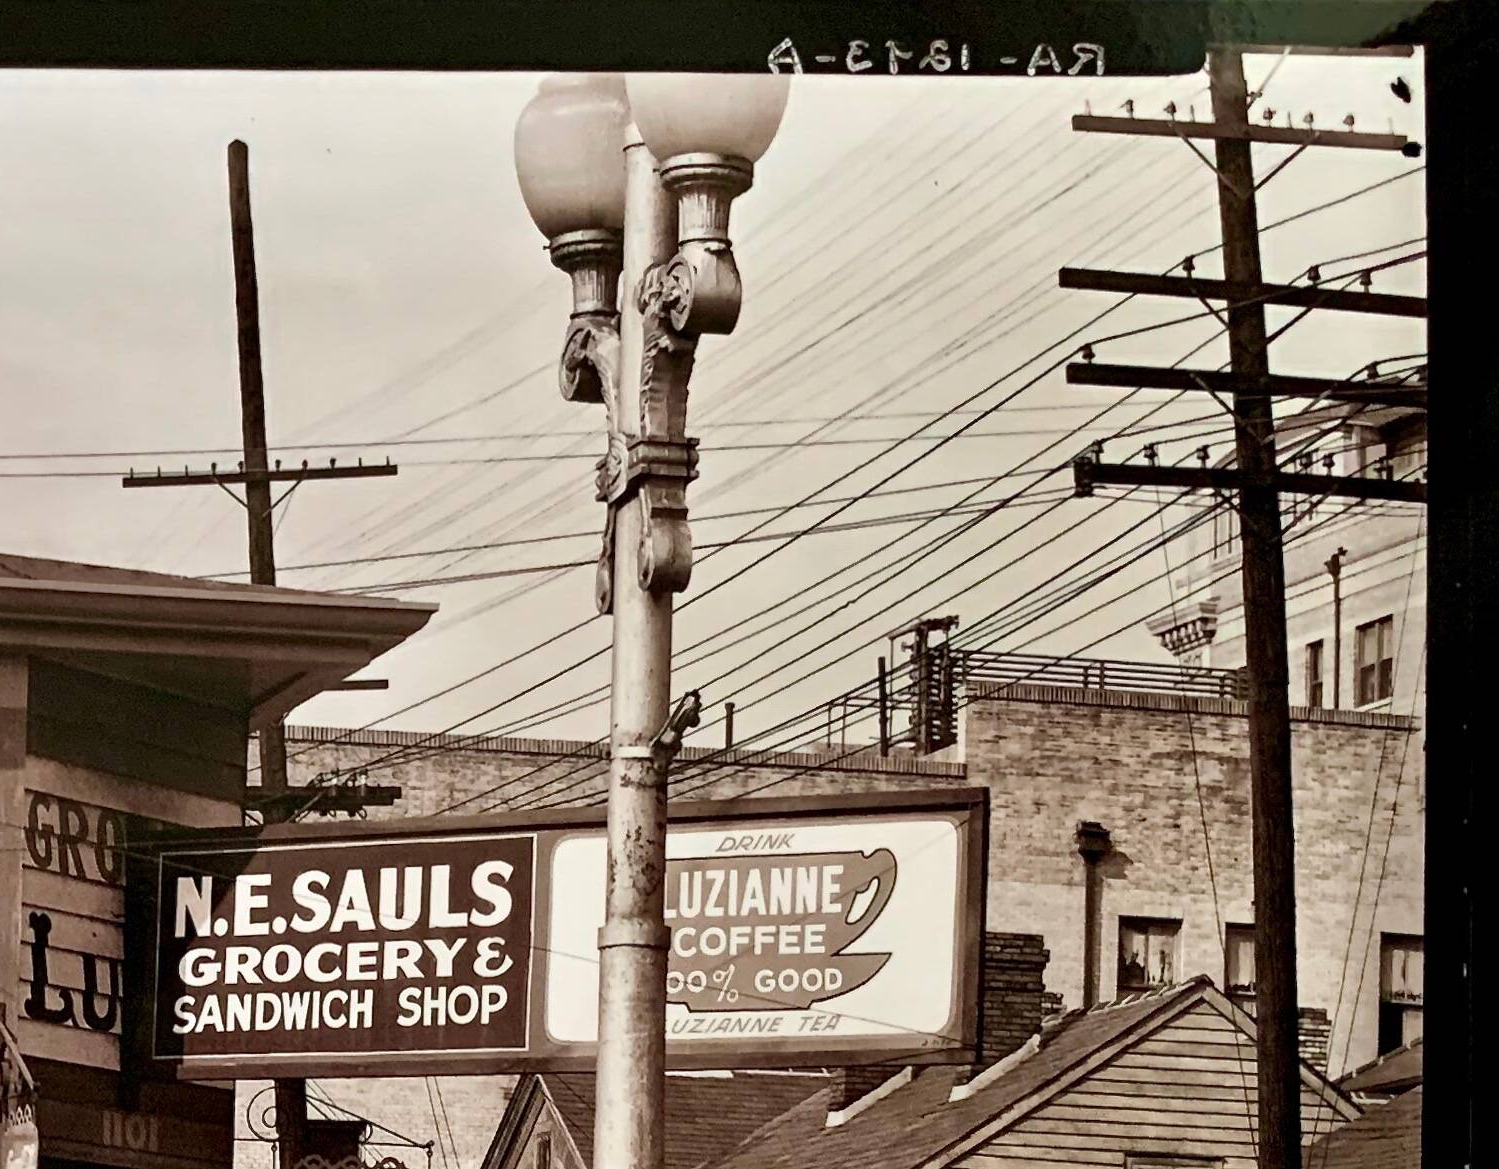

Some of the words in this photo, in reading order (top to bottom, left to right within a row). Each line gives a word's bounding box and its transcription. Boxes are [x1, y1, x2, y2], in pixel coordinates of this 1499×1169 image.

[24, 793, 122, 886] GRO
[716, 834, 796, 852] DRINK
[664, 865, 844, 919] LUZIANNE
[179, 938, 468, 986] GROCERY
[473, 936, 514, 978] &
[674, 924, 827, 957] COFFEE
[24, 911, 121, 1033] LU
[666, 964, 739, 1002] 00%
[755, 968, 843, 993] GOOD
[173, 989, 375, 1034] SANDWICH
[398, 985, 508, 1028] SHOP
[671, 1017, 783, 1035] UZIANNE
[799, 1013, 842, 1031] TEA
